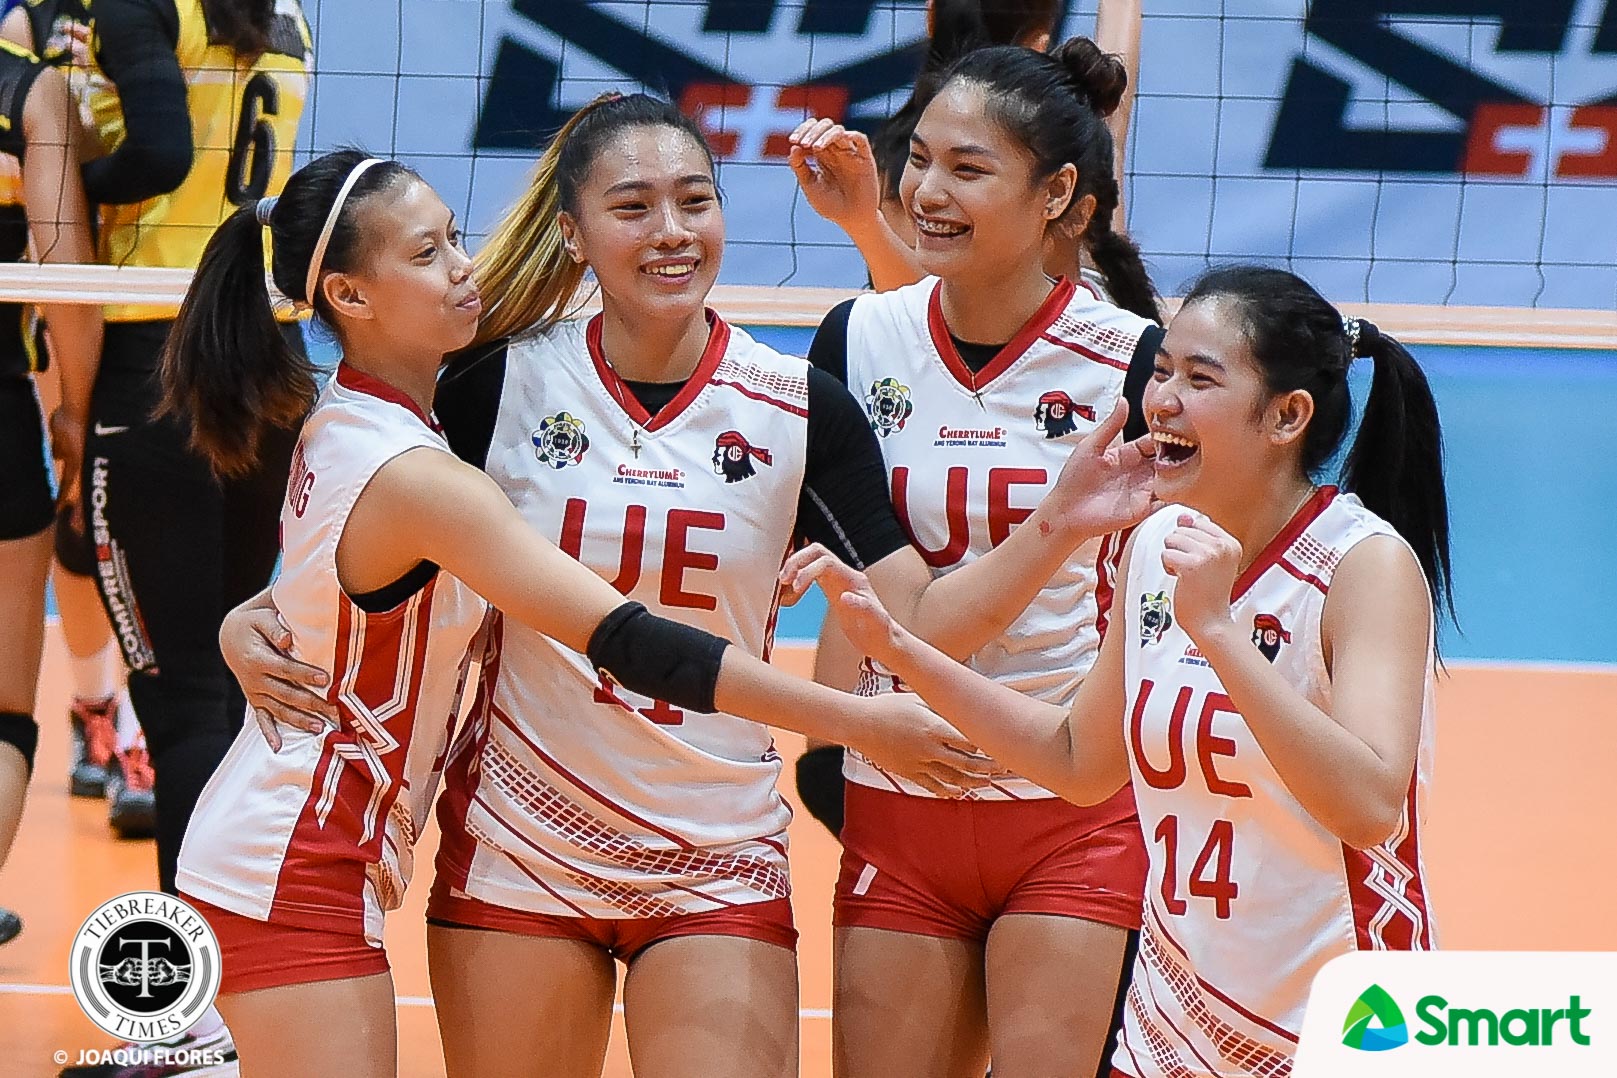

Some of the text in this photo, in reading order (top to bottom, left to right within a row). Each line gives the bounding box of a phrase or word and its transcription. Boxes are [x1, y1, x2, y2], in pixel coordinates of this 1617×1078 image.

[227, 73, 279, 205] 6
[559, 497, 725, 612] UE
[891, 467, 1047, 568] UE
[1131, 679, 1252, 799] UE
[1154, 814, 1239, 920] 14
